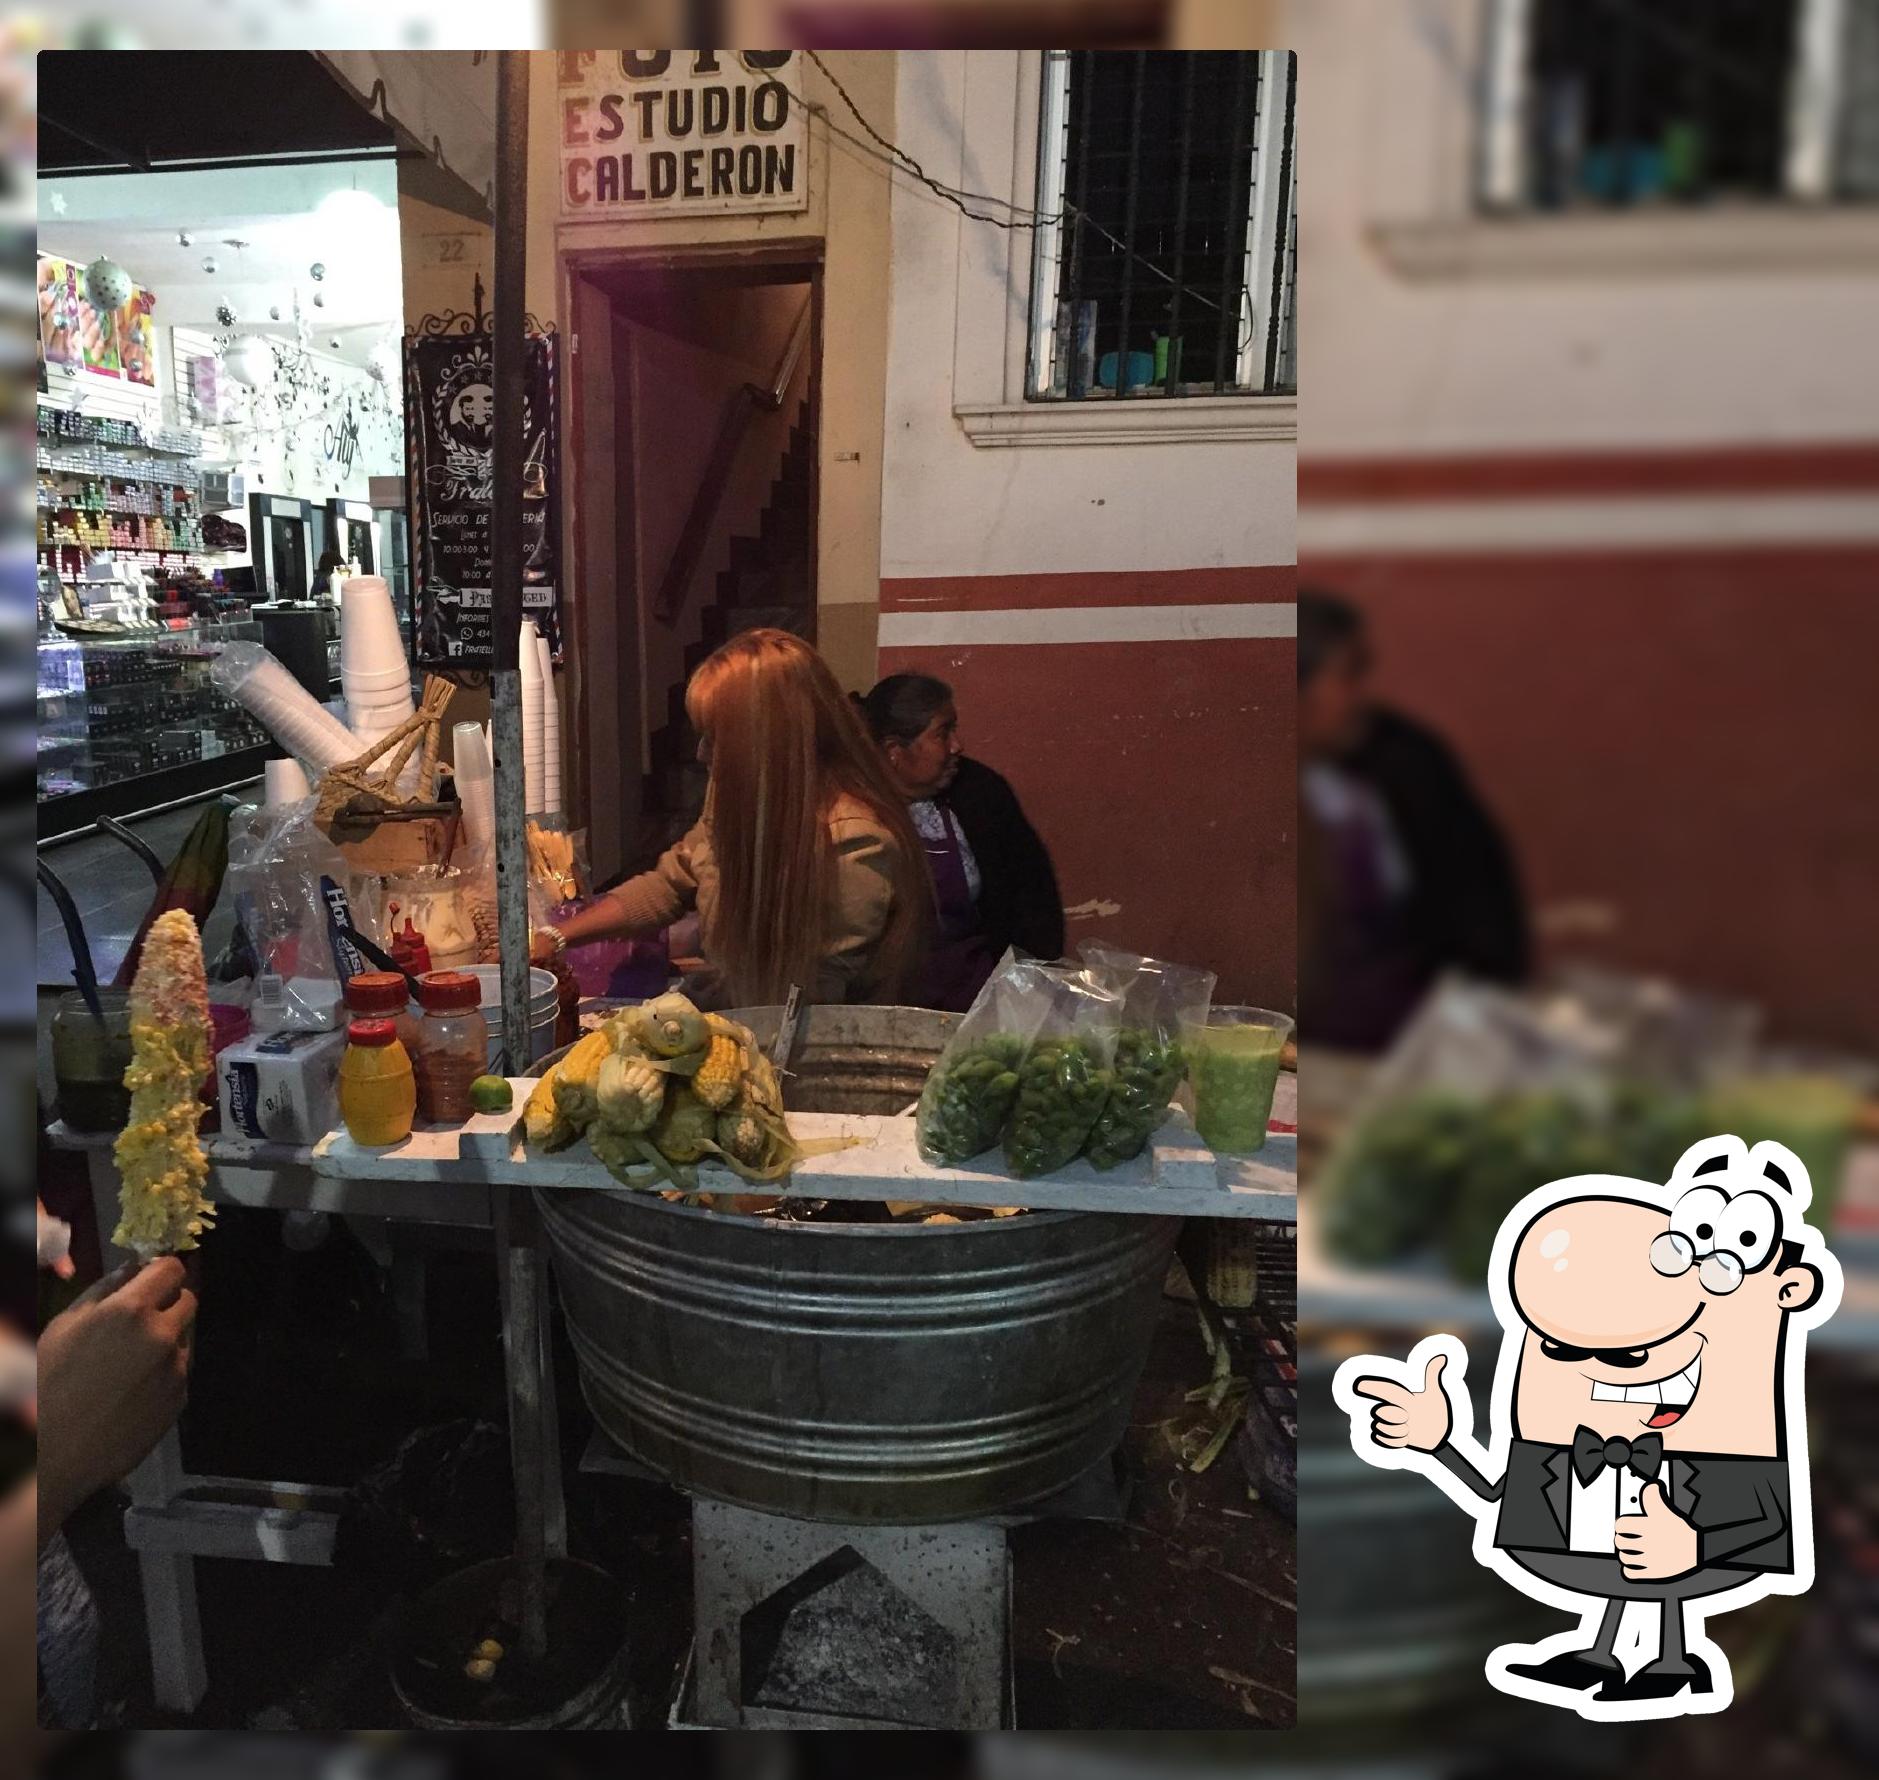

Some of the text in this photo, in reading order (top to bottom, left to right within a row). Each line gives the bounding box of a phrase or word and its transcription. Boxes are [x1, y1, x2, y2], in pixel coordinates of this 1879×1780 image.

[564, 81, 789, 143] ESTUDIO
[566, 144, 795, 203] CALDERON
[440, 239, 464, 262] 22
[475, 514, 489, 525] DE
[522, 512, 546, 524] ERIA
